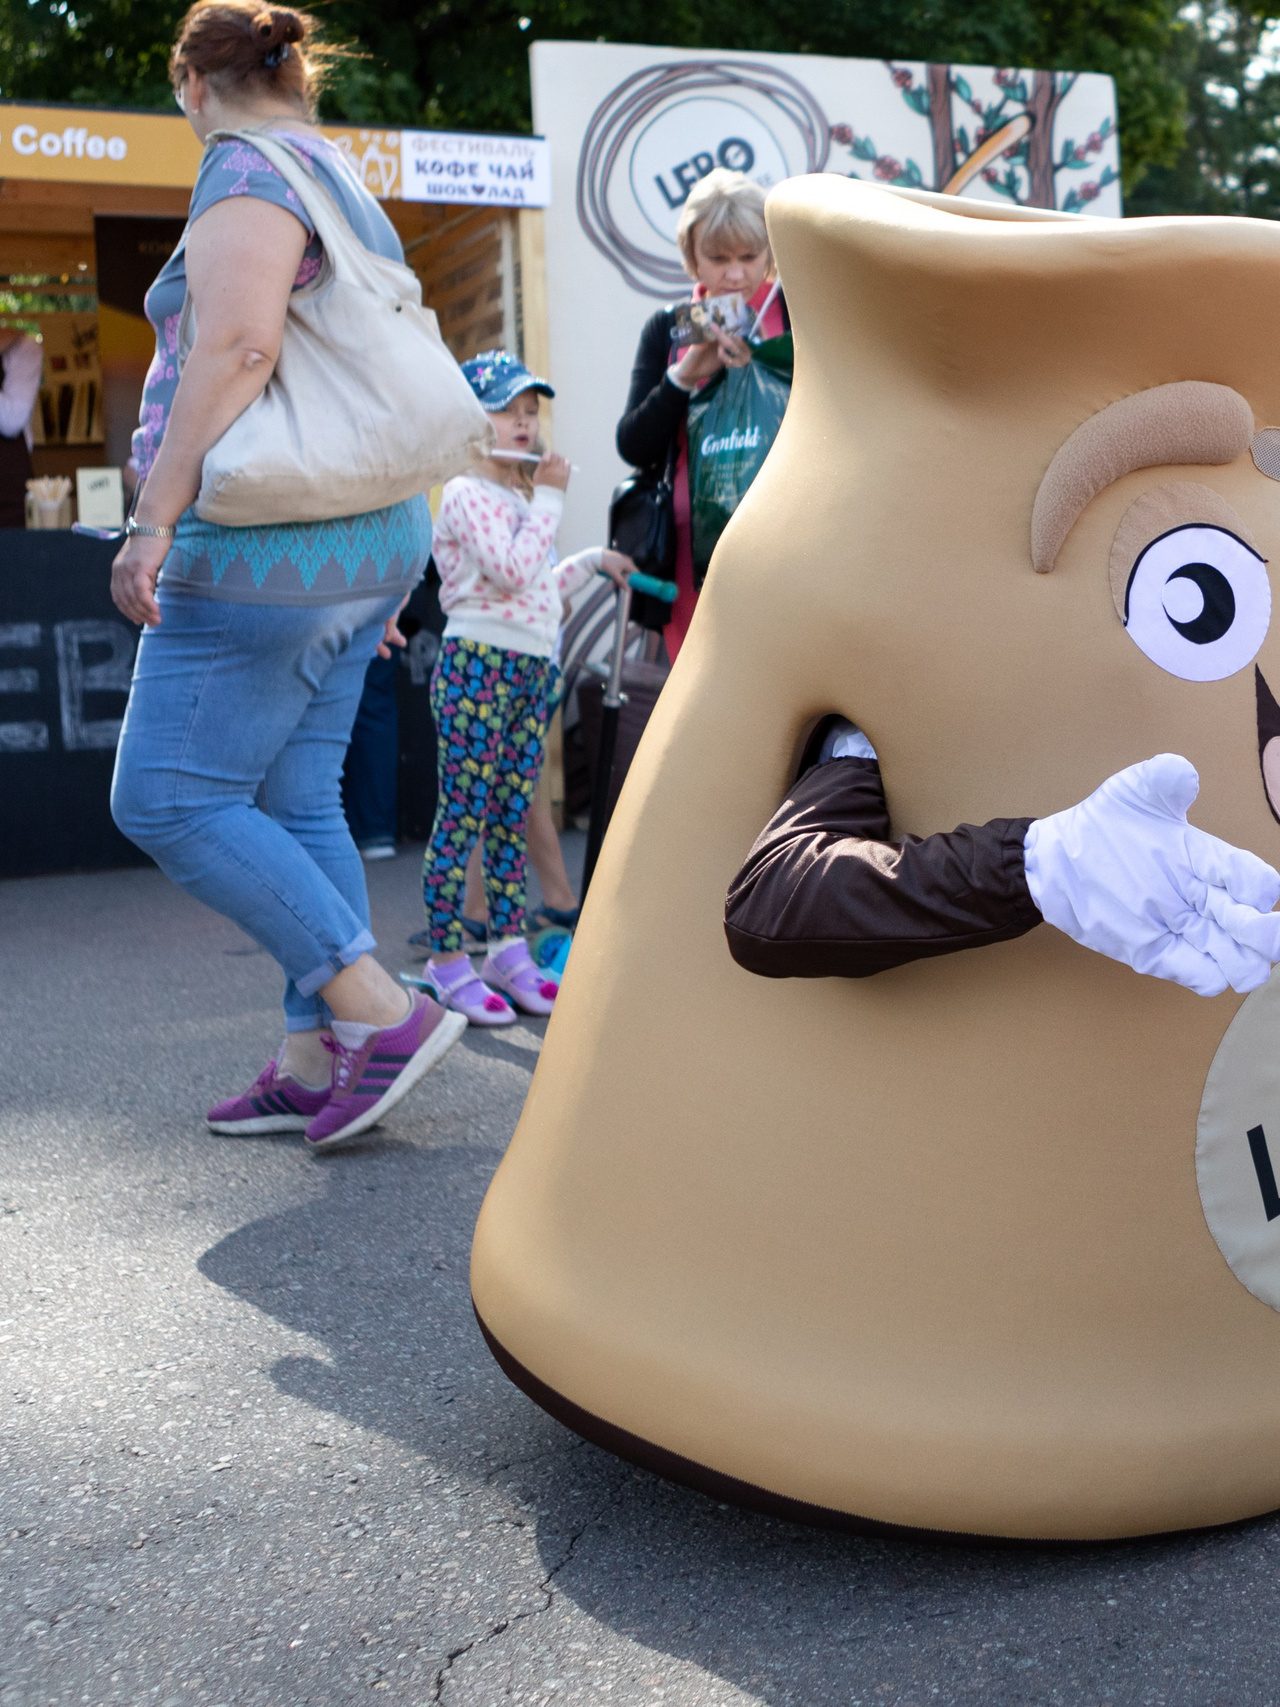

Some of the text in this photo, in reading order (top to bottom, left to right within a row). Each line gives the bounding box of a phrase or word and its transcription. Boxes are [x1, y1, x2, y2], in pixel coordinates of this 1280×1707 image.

[12, 124, 127, 160] Coffee
[411, 136, 535, 159] ФЕСТИВАЛЬ
[415, 159, 534, 180] КОФЕ ЧАЙ
[701, 426, 759, 456] Grnfield
